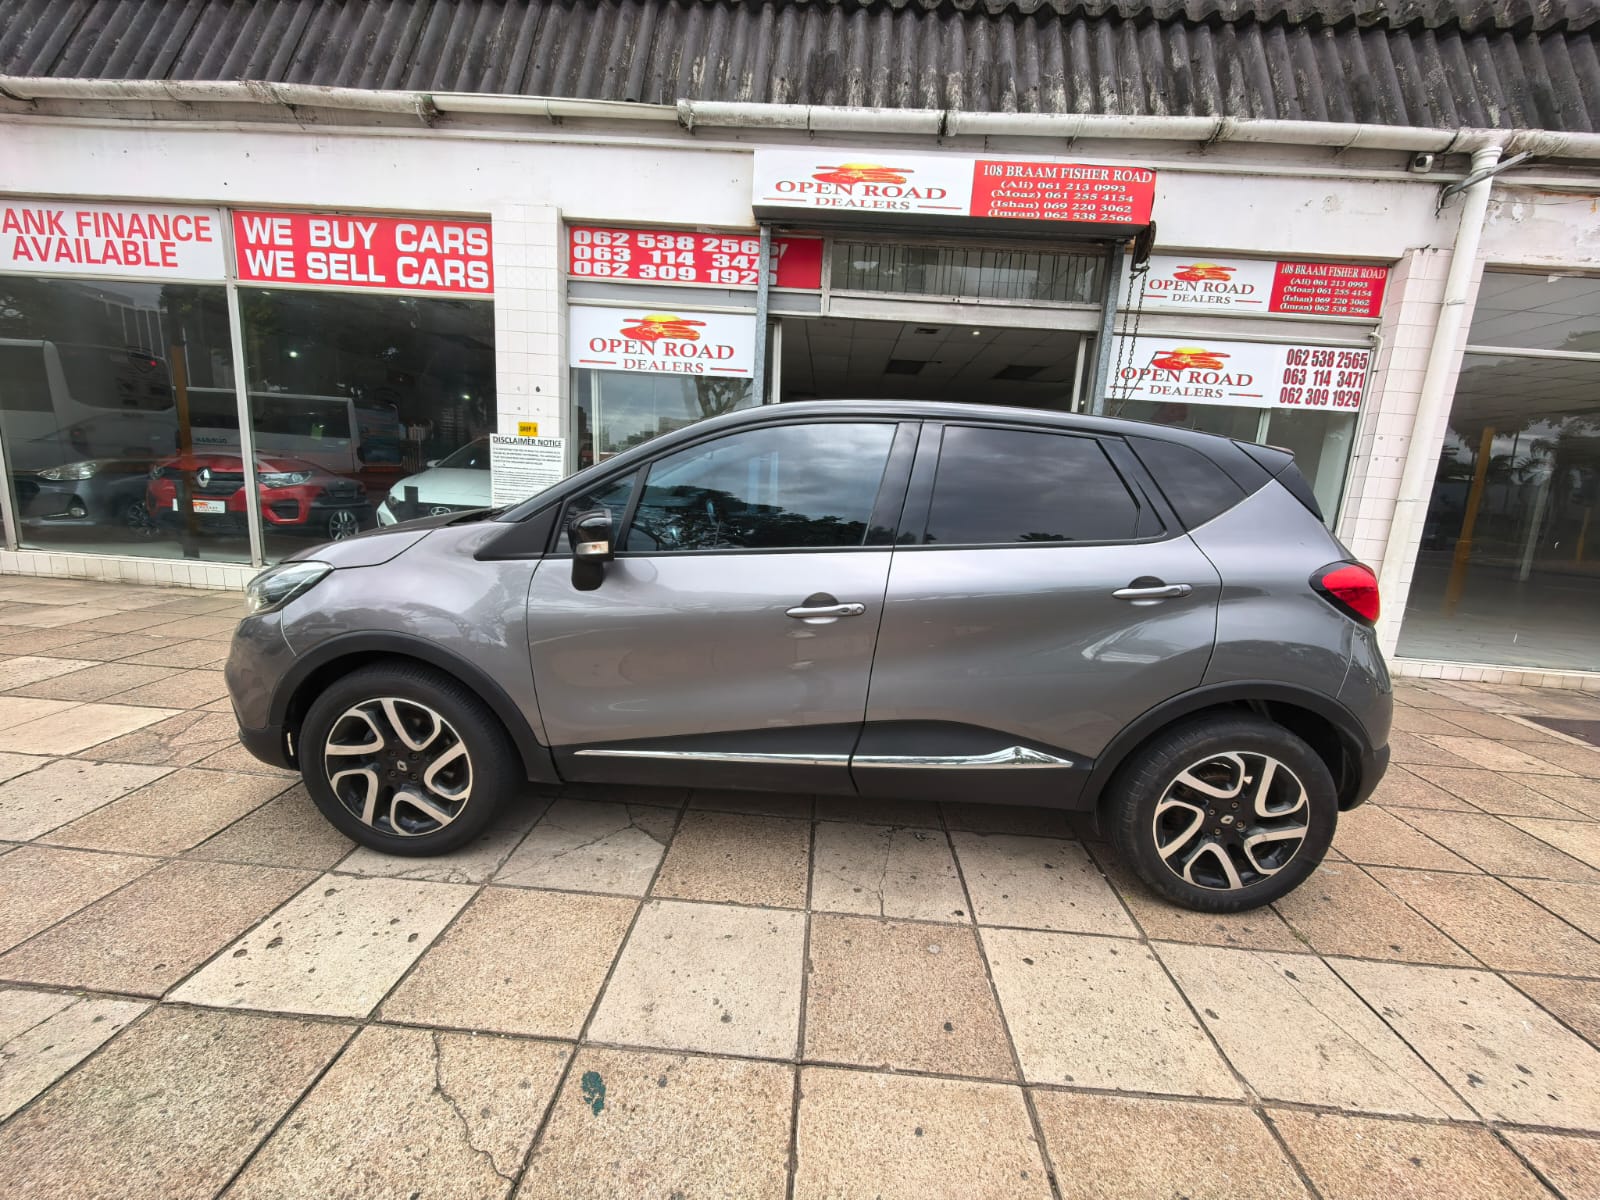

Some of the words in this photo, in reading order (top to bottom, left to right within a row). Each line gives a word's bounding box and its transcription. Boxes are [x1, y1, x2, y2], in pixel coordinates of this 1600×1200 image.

[983, 164, 1002, 177] 108
[1005, 165, 1057, 179] BRAAM
[1060, 168, 1110, 182] FISHER
[1114, 170, 1153, 183] ROAD
[775, 181, 853, 196] OPEN
[864, 184, 947, 200] ROAD
[1000, 180, 1034, 190] (Ali)
[1037, 182, 1060, 190] 061
[1065, 183, 1090, 191] 213
[1094, 184, 1126, 192] 0993
[815, 197, 910, 210] DEALERS
[990, 190, 1042, 199] (Moaz)
[1044, 191, 1068, 200] 061
[1074, 192, 1097, 201] 255
[1102, 194, 1134, 203] 4154
[987, 208, 1041, 219] (Imran)
[1044, 210, 1068, 219] 062
[1073, 211, 1097, 221] 538
[1101, 213, 1132, 222] 2566
[990, 200, 1040, 210] (Ishan)
[1043, 201, 1067, 209] 069
[1072, 203, 1096, 211] 220
[1100, 204, 1132, 213] 3062
[2, 208, 68, 237] ANK
[76, 211, 213, 242] FINANCE
[242, 216, 293, 246] WE
[309, 219, 377, 250] BUY
[395, 224, 489, 256] CARS
[573, 230, 629, 247] 062
[637, 233, 694, 251] 538
[12, 236, 179, 267] AVAILABLE
[573, 245, 631, 262] 063
[648, 250, 695, 266] 114
[245, 249, 296, 278] WE
[306, 252, 386, 283] SELL
[396, 256, 489, 289] CARS
[573, 261, 629, 277] 062
[639, 265, 696, 281] 309
[1295, 264, 1327, 276] BRAAM
[1328, 266, 1359, 278] FISHER
[1361, 268, 1386, 279] ROAD
[1149, 279, 1197, 292] OPEN
[1204, 282, 1254, 294] ROAD
[1172, 293, 1231, 304] DEALERS
[589, 337, 656, 356] OPEN
[663, 341, 734, 360] ROAD
[623, 358, 704, 374] DEALERS
[1286, 348, 1310, 366] 062
[1311, 350, 1335, 368] 538
[1336, 351, 1368, 370] 2565
[1120, 367, 1183, 383] OPEN
[1187, 370, 1253, 387] ROAD
[1283, 368, 1307, 385] 063
[1313, 369, 1332, 387] 114
[1337, 371, 1365, 388] 3471
[1149, 385, 1223, 398] DEALERS
[1279, 387, 1303, 404] 062
[1305, 388, 1329, 405] 309
[1332, 390, 1360, 407] 1929
[493, 436, 536, 446] DISCLAIMER
[538, 439, 562, 448] NOTICE
